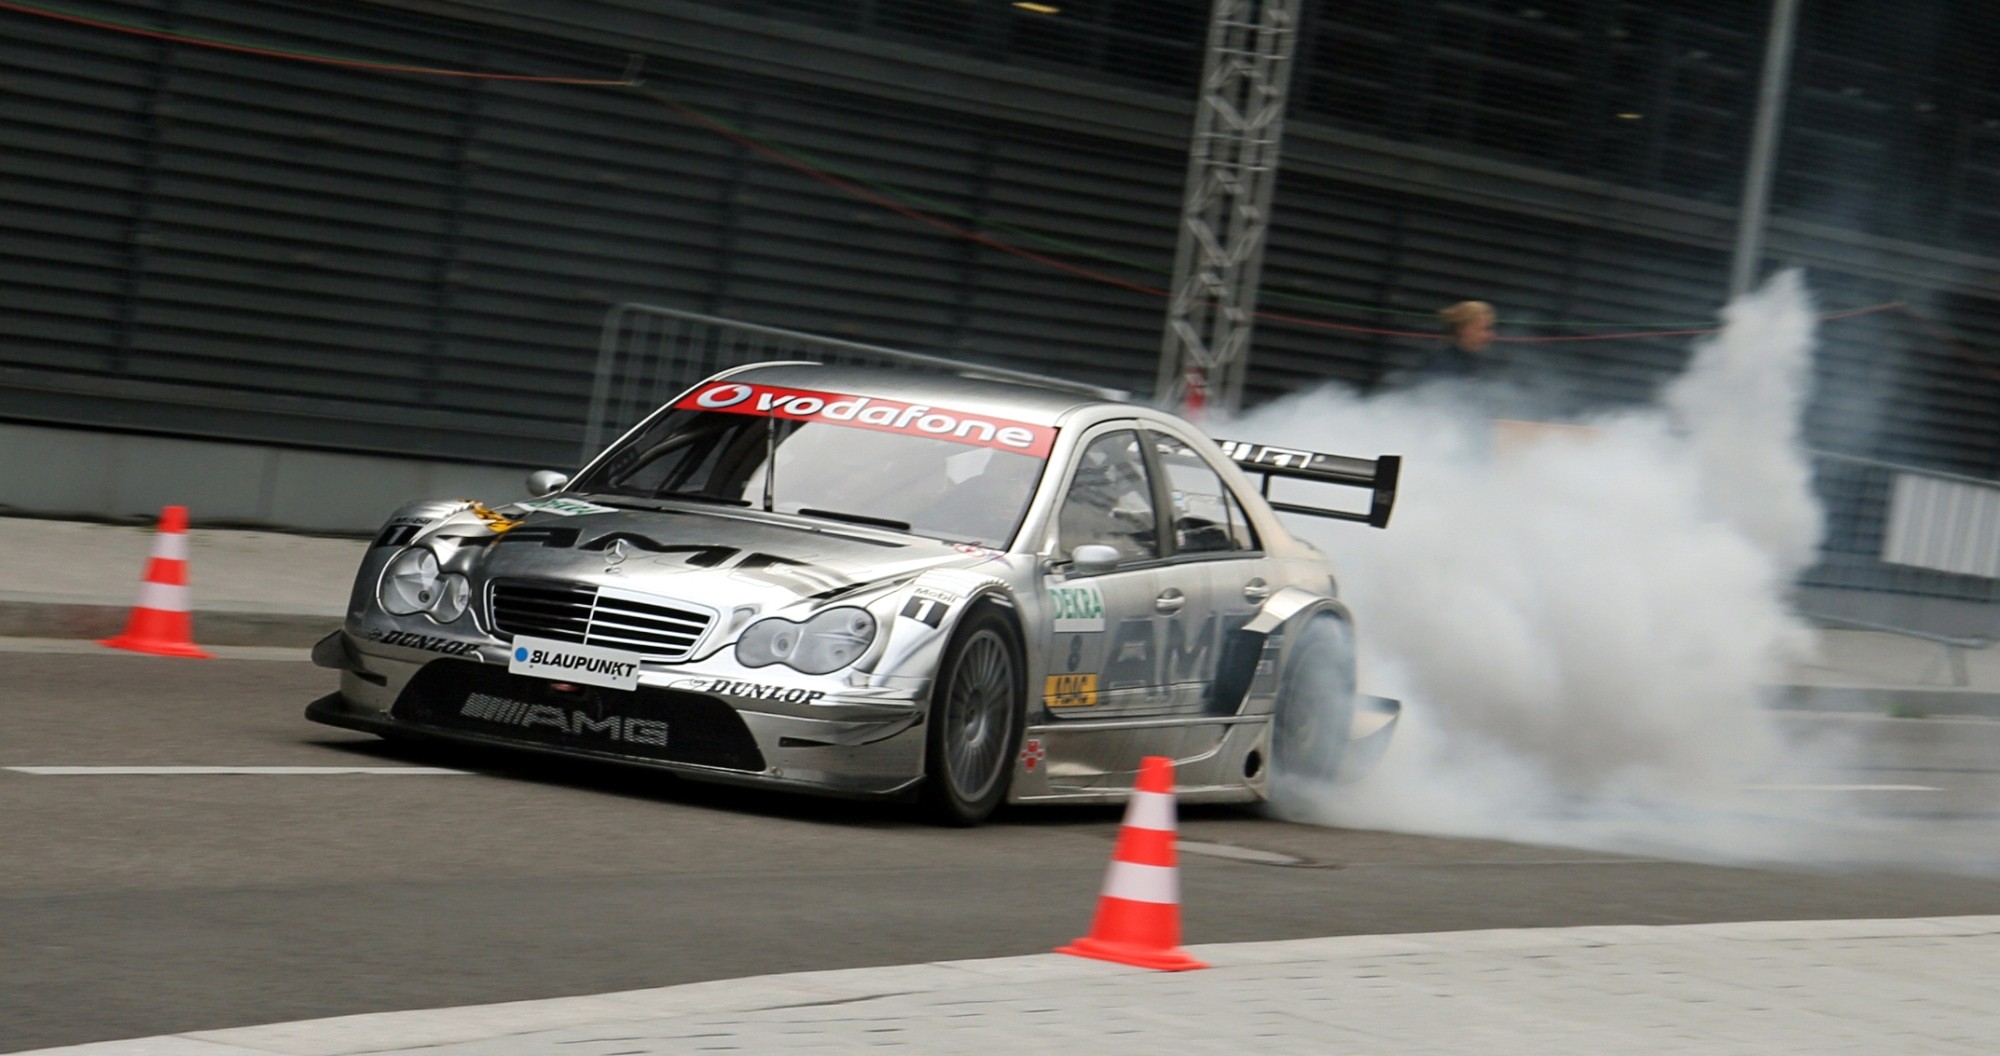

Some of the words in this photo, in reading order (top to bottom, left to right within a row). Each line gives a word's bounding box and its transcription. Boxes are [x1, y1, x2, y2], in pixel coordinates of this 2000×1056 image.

[756, 391, 1034, 448] vodafone
[913, 587, 958, 603] Mobil
[1048, 588, 1105, 619] DEKRA
[914, 599, 936, 622] 1
[380, 630, 480, 655] DUNLOP
[530, 649, 637, 677] BLAUPUNKT
[706, 679, 826, 705] DUNLOP
[521, 704, 669, 747] AMG
